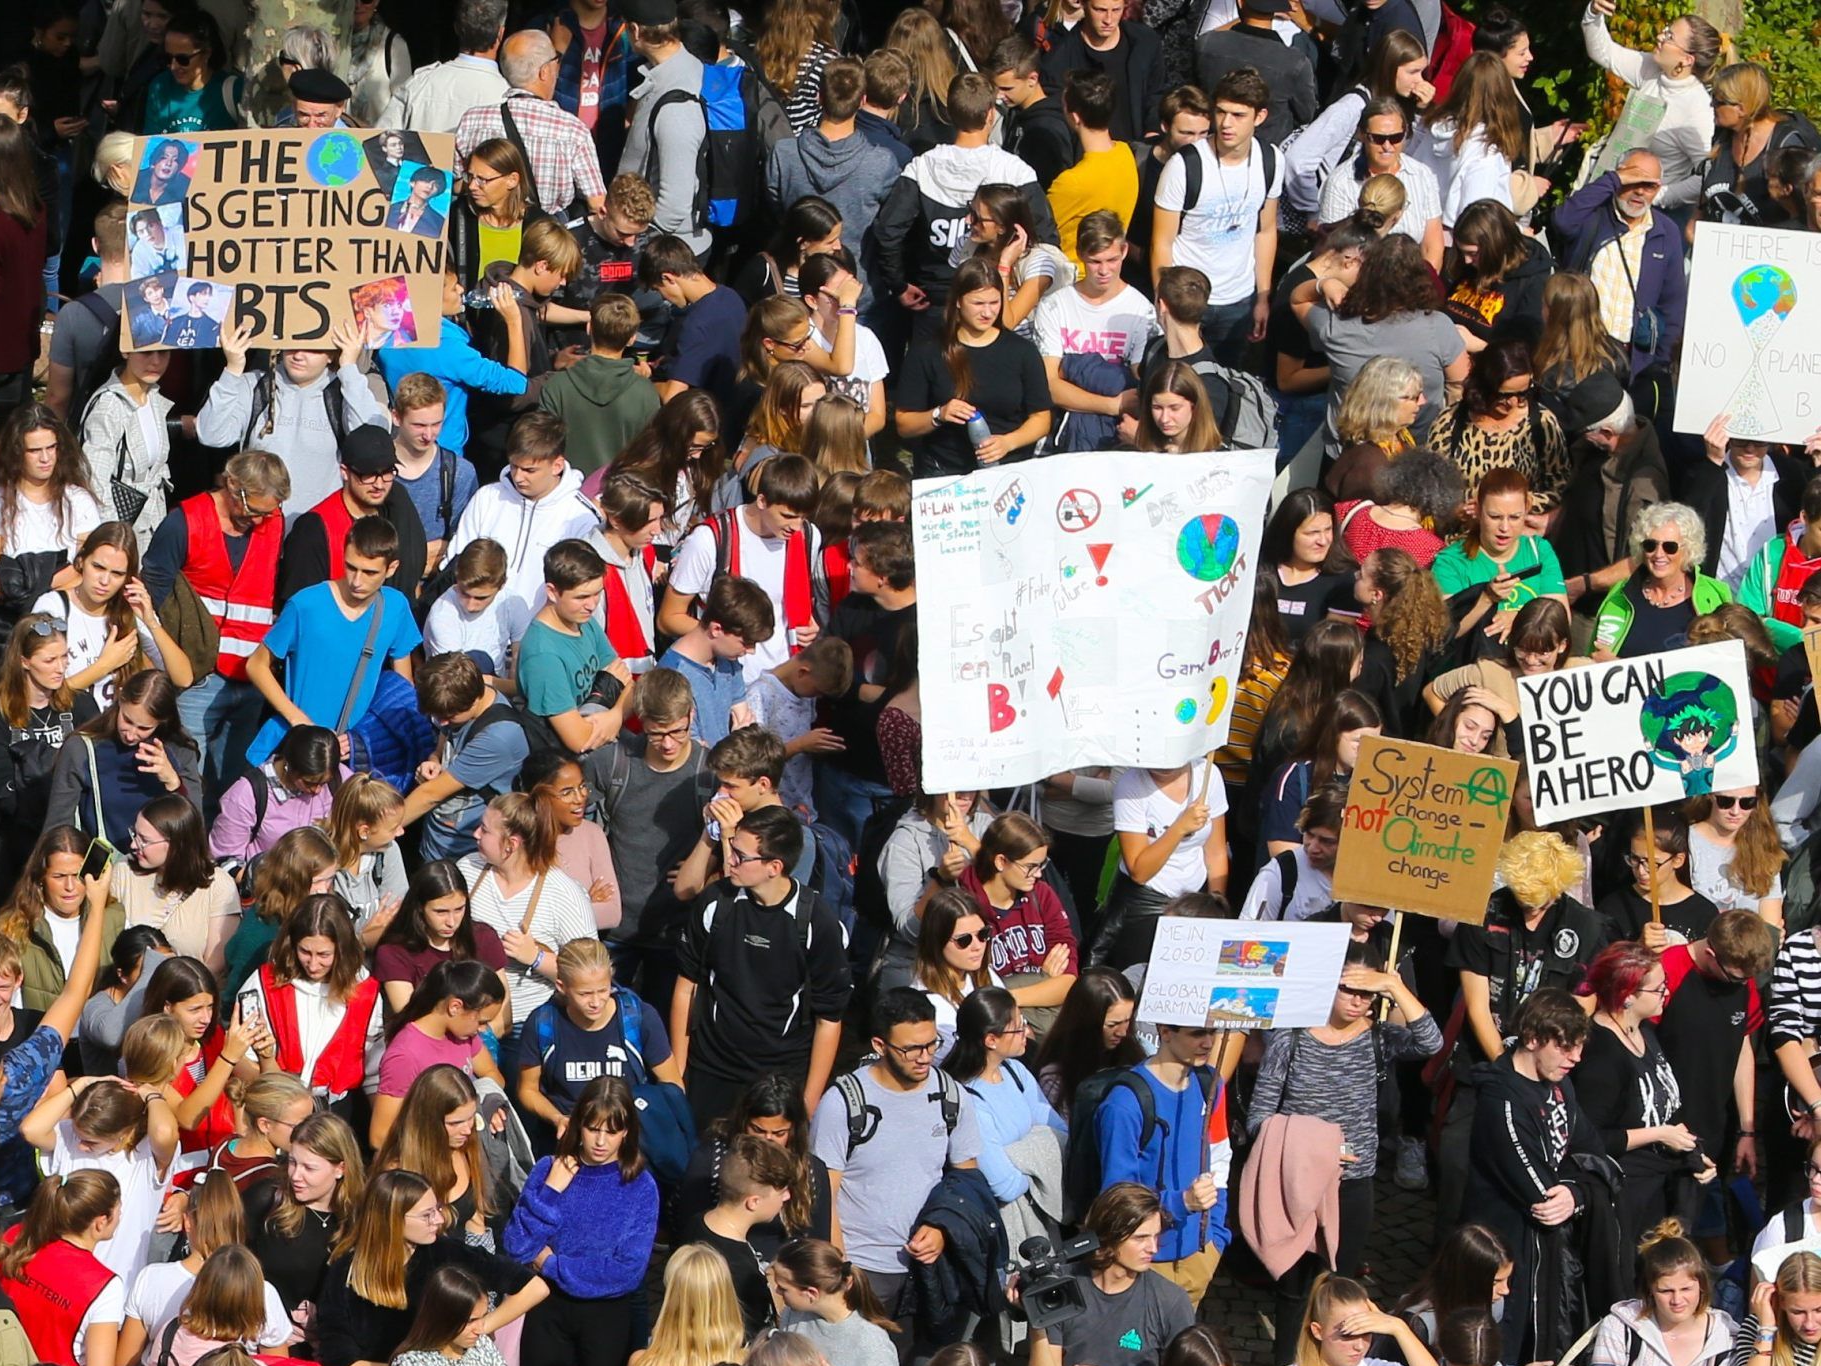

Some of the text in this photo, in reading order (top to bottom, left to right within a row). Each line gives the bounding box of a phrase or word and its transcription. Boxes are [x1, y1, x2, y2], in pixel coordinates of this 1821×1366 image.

[204, 140, 302, 184] THE
[182, 187, 385, 233] IS GETTING
[187, 237, 443, 277] HOTTER THAN
[1711, 231, 1790, 261] THERE
[235, 281, 330, 341] BTS
[1691, 341, 1726, 369] NO
[1796, 391, 1812, 417] B
[1146, 491, 1185, 528] DIE
[1522, 658, 1666, 720] YOU CAN
[1529, 717, 1586, 765] BE
[1360, 748, 1463, 807] System
[1344, 798, 1390, 833] not
[1394, 800, 1462, 830] change
[1388, 856, 1450, 889] change
[1159, 925, 1204, 941] ME IN
[1143, 999, 1207, 1016] WARMING
[1147, 982, 1207, 999] GLOBAL
